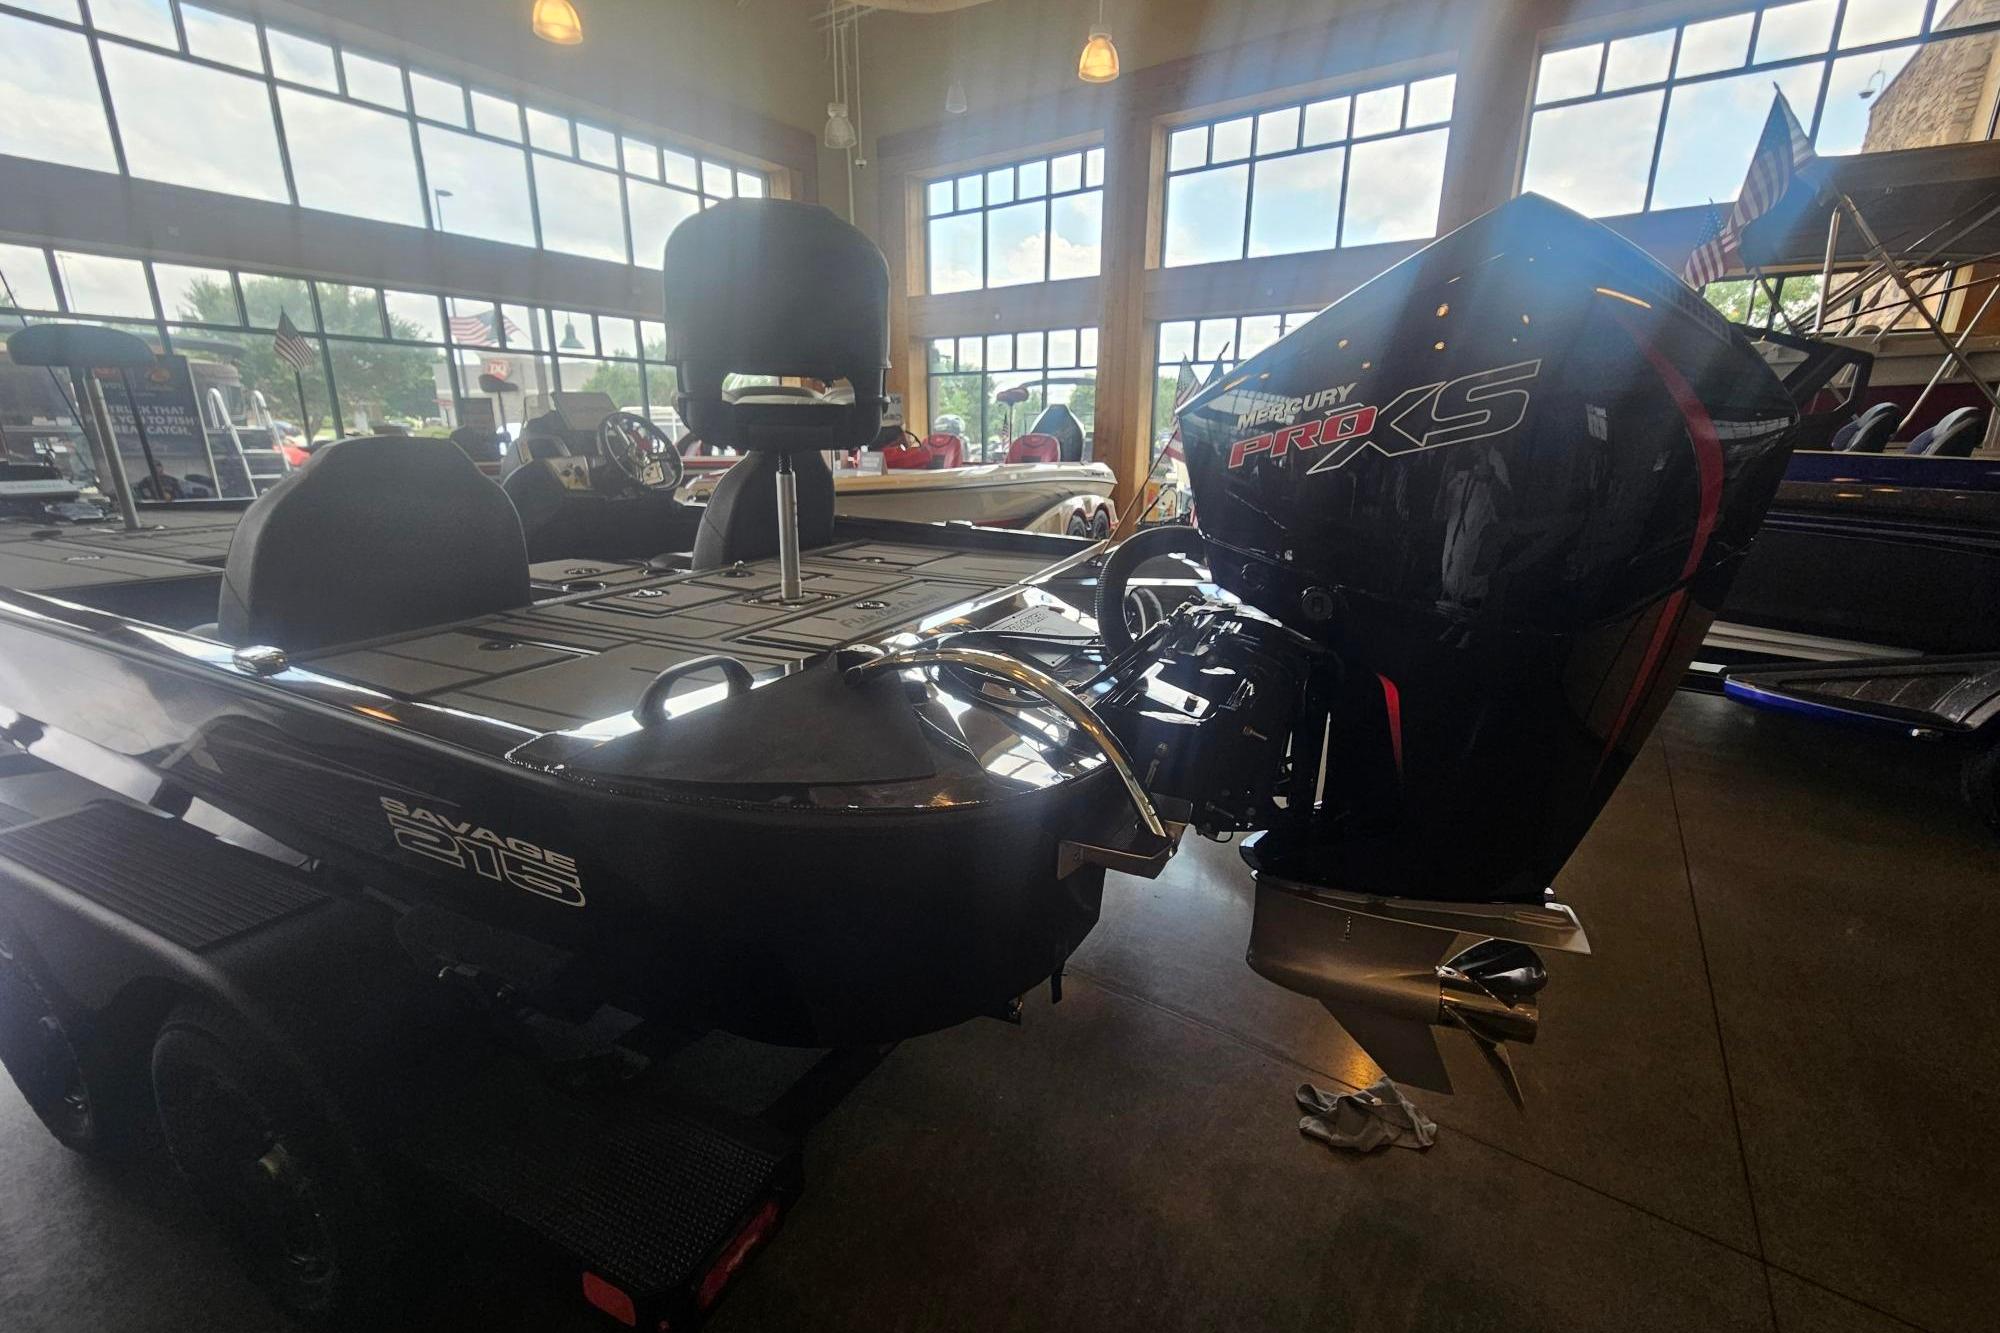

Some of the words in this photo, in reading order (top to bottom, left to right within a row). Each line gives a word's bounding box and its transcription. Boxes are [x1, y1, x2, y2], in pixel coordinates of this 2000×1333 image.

[1228, 406, 1378, 469] PRO
[1238, 383, 1357, 430] MERCURY
[379, 796, 577, 873] SAVAGE
